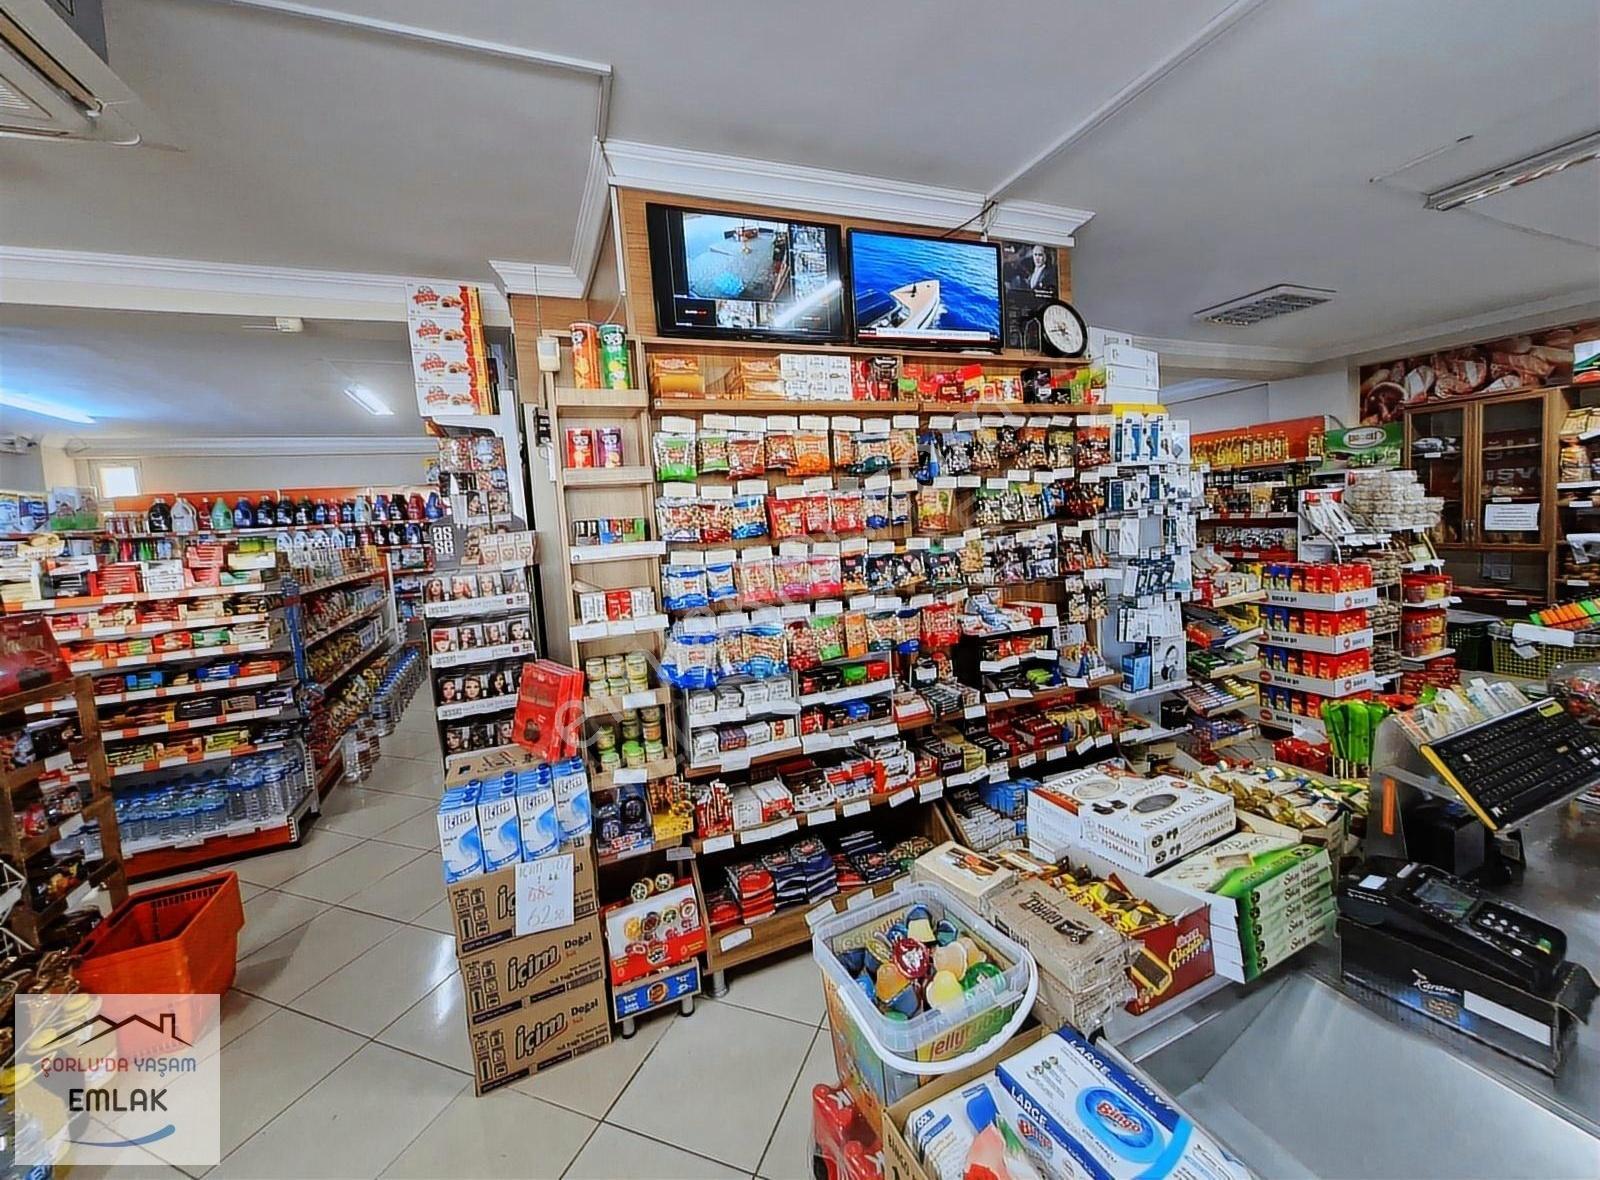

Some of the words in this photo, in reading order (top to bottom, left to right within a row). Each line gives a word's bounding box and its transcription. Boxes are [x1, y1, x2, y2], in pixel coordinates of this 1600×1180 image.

[564, 931, 593, 949] Doğal
[571, 1000, 599, 1017] Doğal
[1069, 1040, 1111, 1076] LARGE
[1010, 1086, 1048, 1130] LARGE
[1096, 1099, 1143, 1135] Bingo
